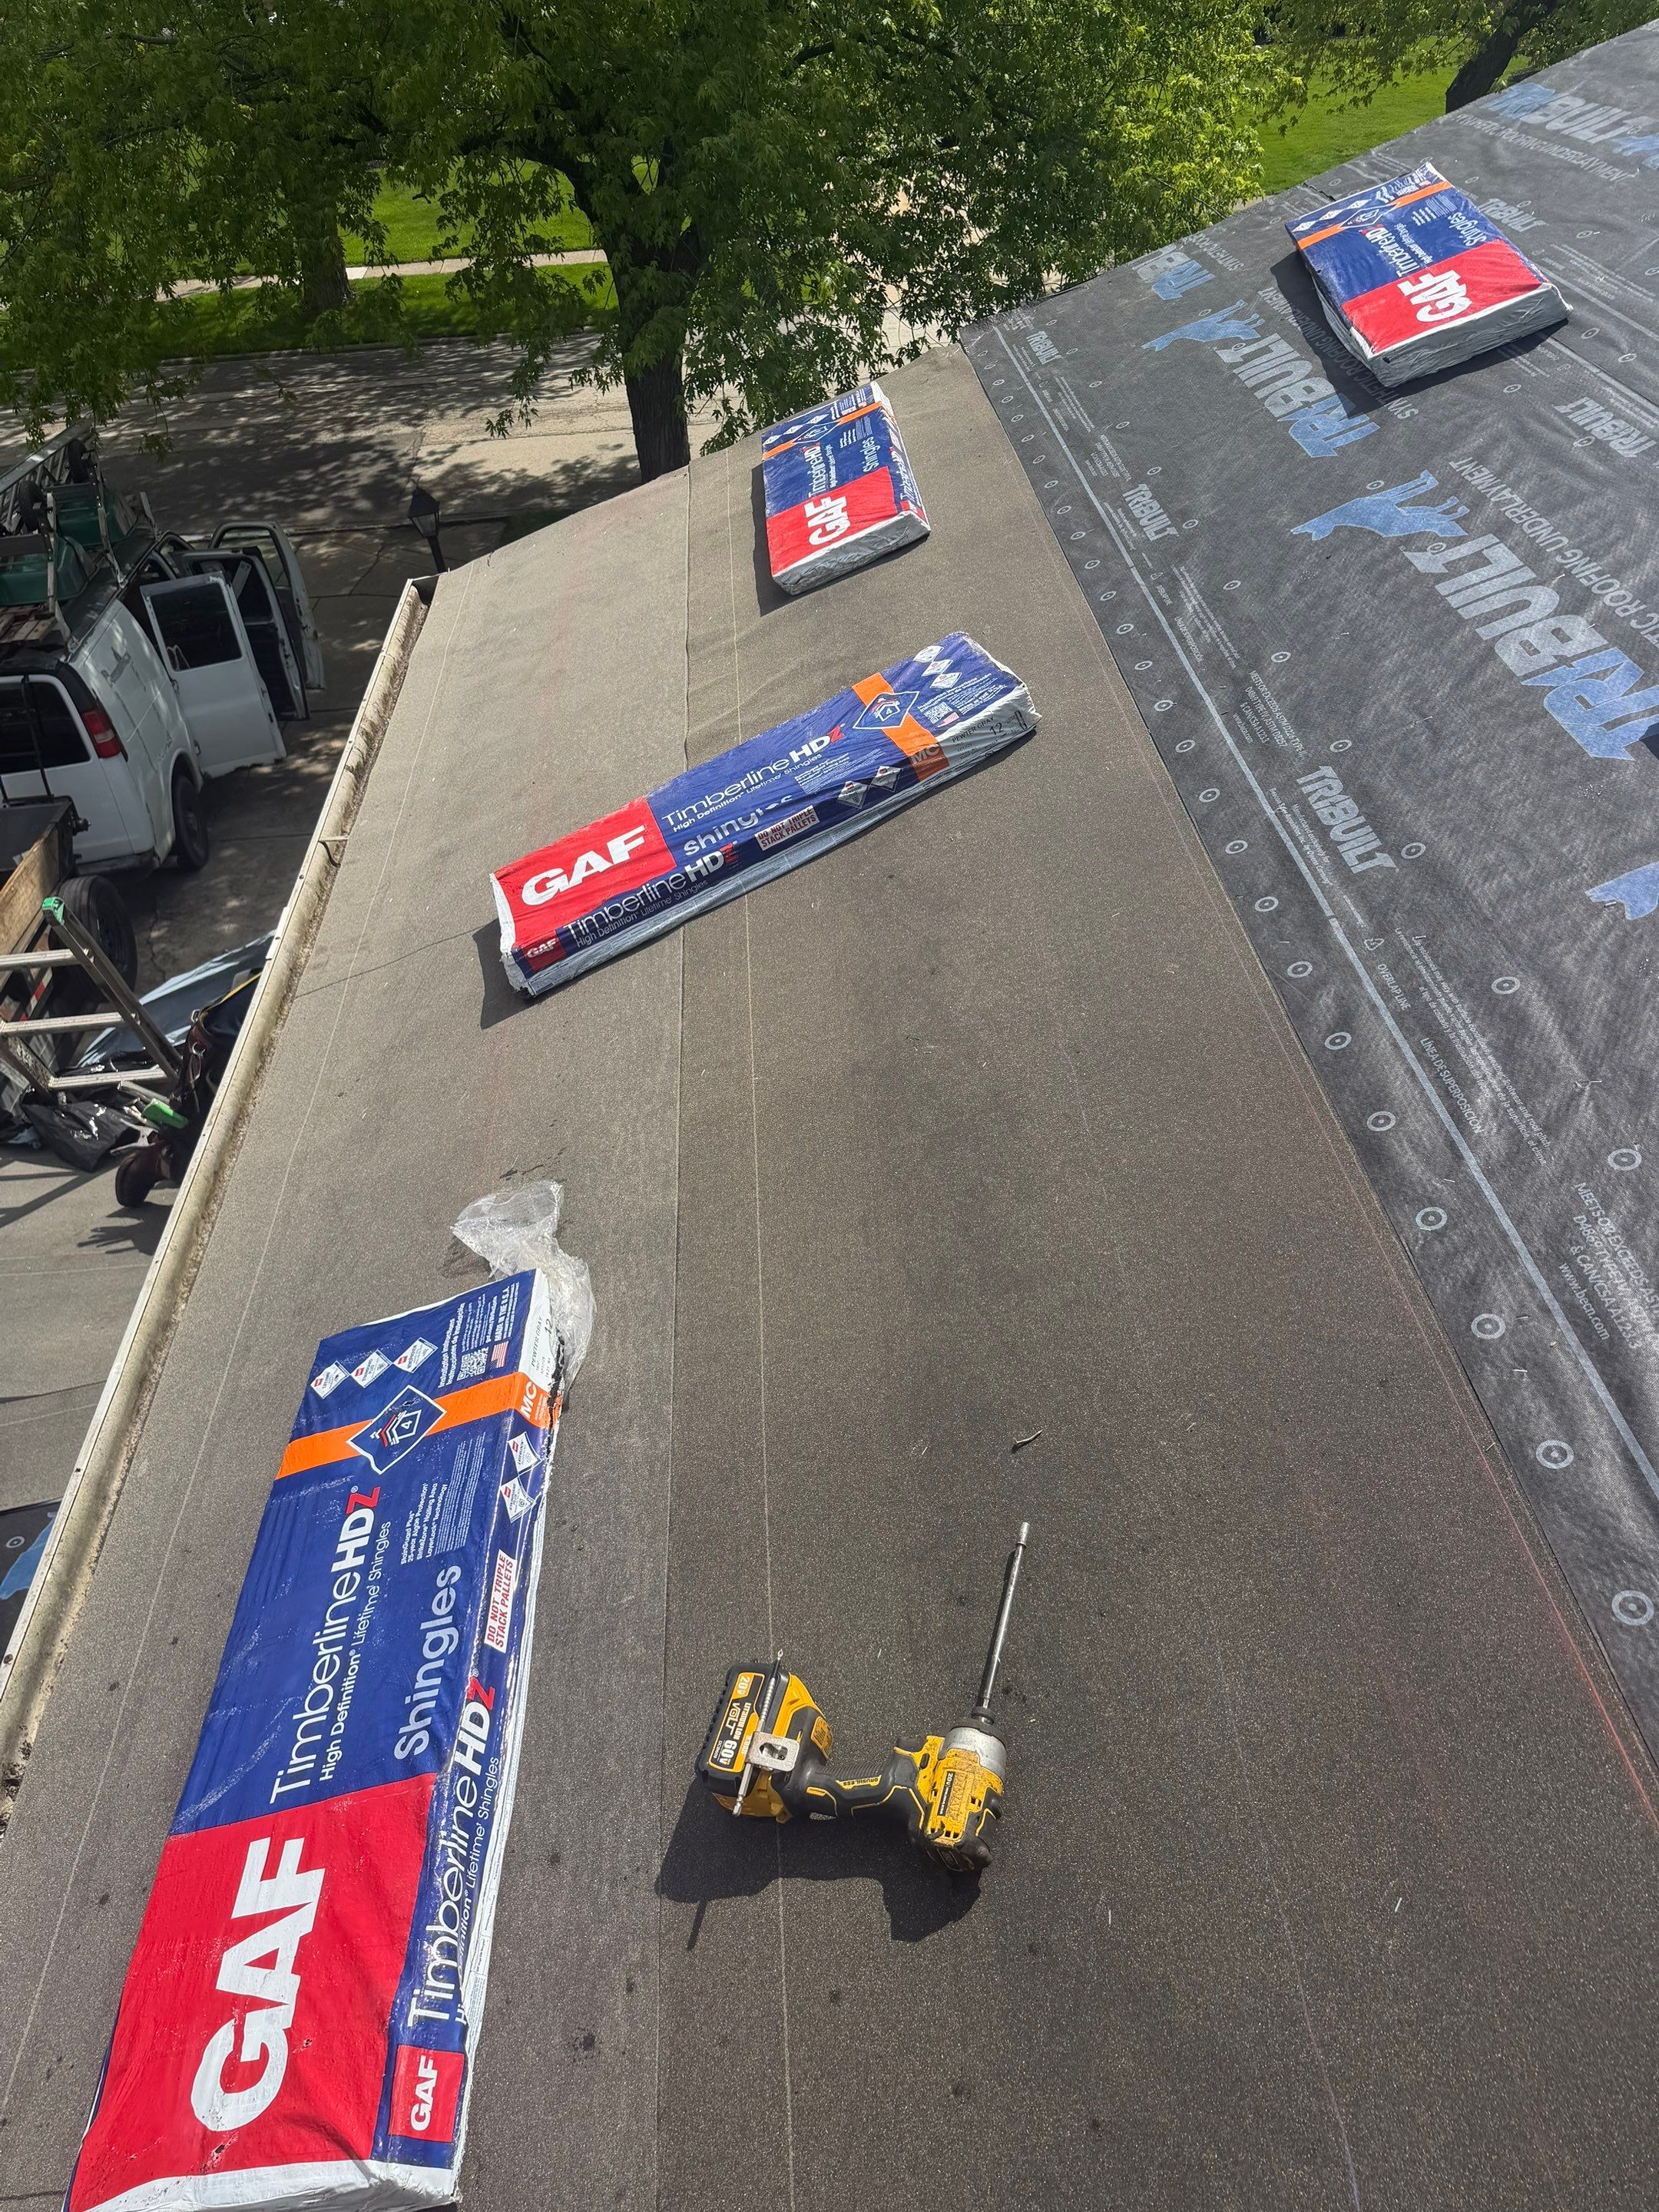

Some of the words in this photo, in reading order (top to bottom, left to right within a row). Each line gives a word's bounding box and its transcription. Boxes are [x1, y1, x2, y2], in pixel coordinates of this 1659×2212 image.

[1445, 210, 1488, 248] Shingles
[1397, 270, 1472, 323] GAF
[1214, 333, 1380, 458] TRIBUILT
[1551, 396, 1657, 458] TRIBUILT
[860, 435, 881, 472] Shingles
[804, 496, 850, 545] GAF
[1122, 483, 1179, 541] TRIBUILT
[1449, 457, 1555, 552] UNDERLAYMENT
[1555, 544, 1646, 618] ROOFING
[952, 726, 976, 743] PEWTER
[977, 716, 995, 729] GRAY
[989, 723, 1003, 735] 12
[1247, 670, 1263, 687] MEETS
[1260, 690, 1280, 714] EXCEEDS
[1273, 710, 1289, 728] ASTM
[1290, 737, 1304, 753] TYPE
[1252, 698, 1266, 714] TYPE
[1263, 716, 1278, 733] ASTM
[910, 743, 939, 764] MC
[662, 757, 790, 826] Timberline
[673, 817, 695, 832] High
[783, 753, 822, 776] Shingles
[1268, 786, 1283, 805] Beacon
[757, 831, 769, 841] DO
[770, 822, 786, 835] NOT
[788, 807, 813, 825] TRIPLE
[760, 833, 786, 848] STACK
[786, 815, 817, 838] PALLETS
[1296, 766, 1399, 874] TRIBUILT
[522, 825, 646, 906] GAF
[563, 873, 687, 939] Timberline
[576, 935, 592, 948] High
[675, 879, 708, 900] Shingles
[527, 939, 556, 958] GAF
[1376, 962, 1402, 995] OVERLAP
[1394, 992, 1411, 1011] LINE
[1419, 1035, 1442, 1061] LÍNEA
[1432, 1056, 1449, 1073] DE
[1438, 1068, 1485, 1135] SUPERPOSICIÓN
[1515, 1103, 1532, 1120] and
[1568, 1242, 1584, 1256] &
[1573, 1180, 1604, 1220] MEETS
[1594, 1214, 1616, 1237] OR
[1605, 1232, 1648, 1289] EXCEEDS
[1559, 1263, 1610, 1340] www.becn.com
[442, 1318, 455, 1352] Instructions
[451, 1335, 459, 1344] de
[495, 1324, 503, 1342] MADE
[545, 1319, 552, 1335] 12
[438, 1353, 449, 1388] Installation
[520, 1381, 537, 1419] MC
[401, 1420, 413, 1429] 4
[423, 1498, 435, 1523] Nailing
[429, 1483, 438, 1498] Area
[433, 1484, 449, 1522] Technology
[401, 1527, 412, 1565] StainGuard
[408, 1538, 416, 1562] 25-year
[495, 1554, 506, 1593] TRIPLE
[501, 1559, 514, 1608] PALLETS
[490, 1598, 499, 1621] NOT
[495, 1610, 508, 1647] STACK
[320, 1739, 343, 1781] High
[369, 1522, 392, 1581] Shingles
[487, 1625, 496, 1643] DO
[395, 1564, 461, 1760] Shingles
[270, 1571, 361, 1804] Timberline
[478, 1757, 499, 1820] Shingles
[407, 1775, 478, 2028] Timberline
[190, 1837, 326, 2131] GAF
[410, 2055, 439, 2131] GAF
